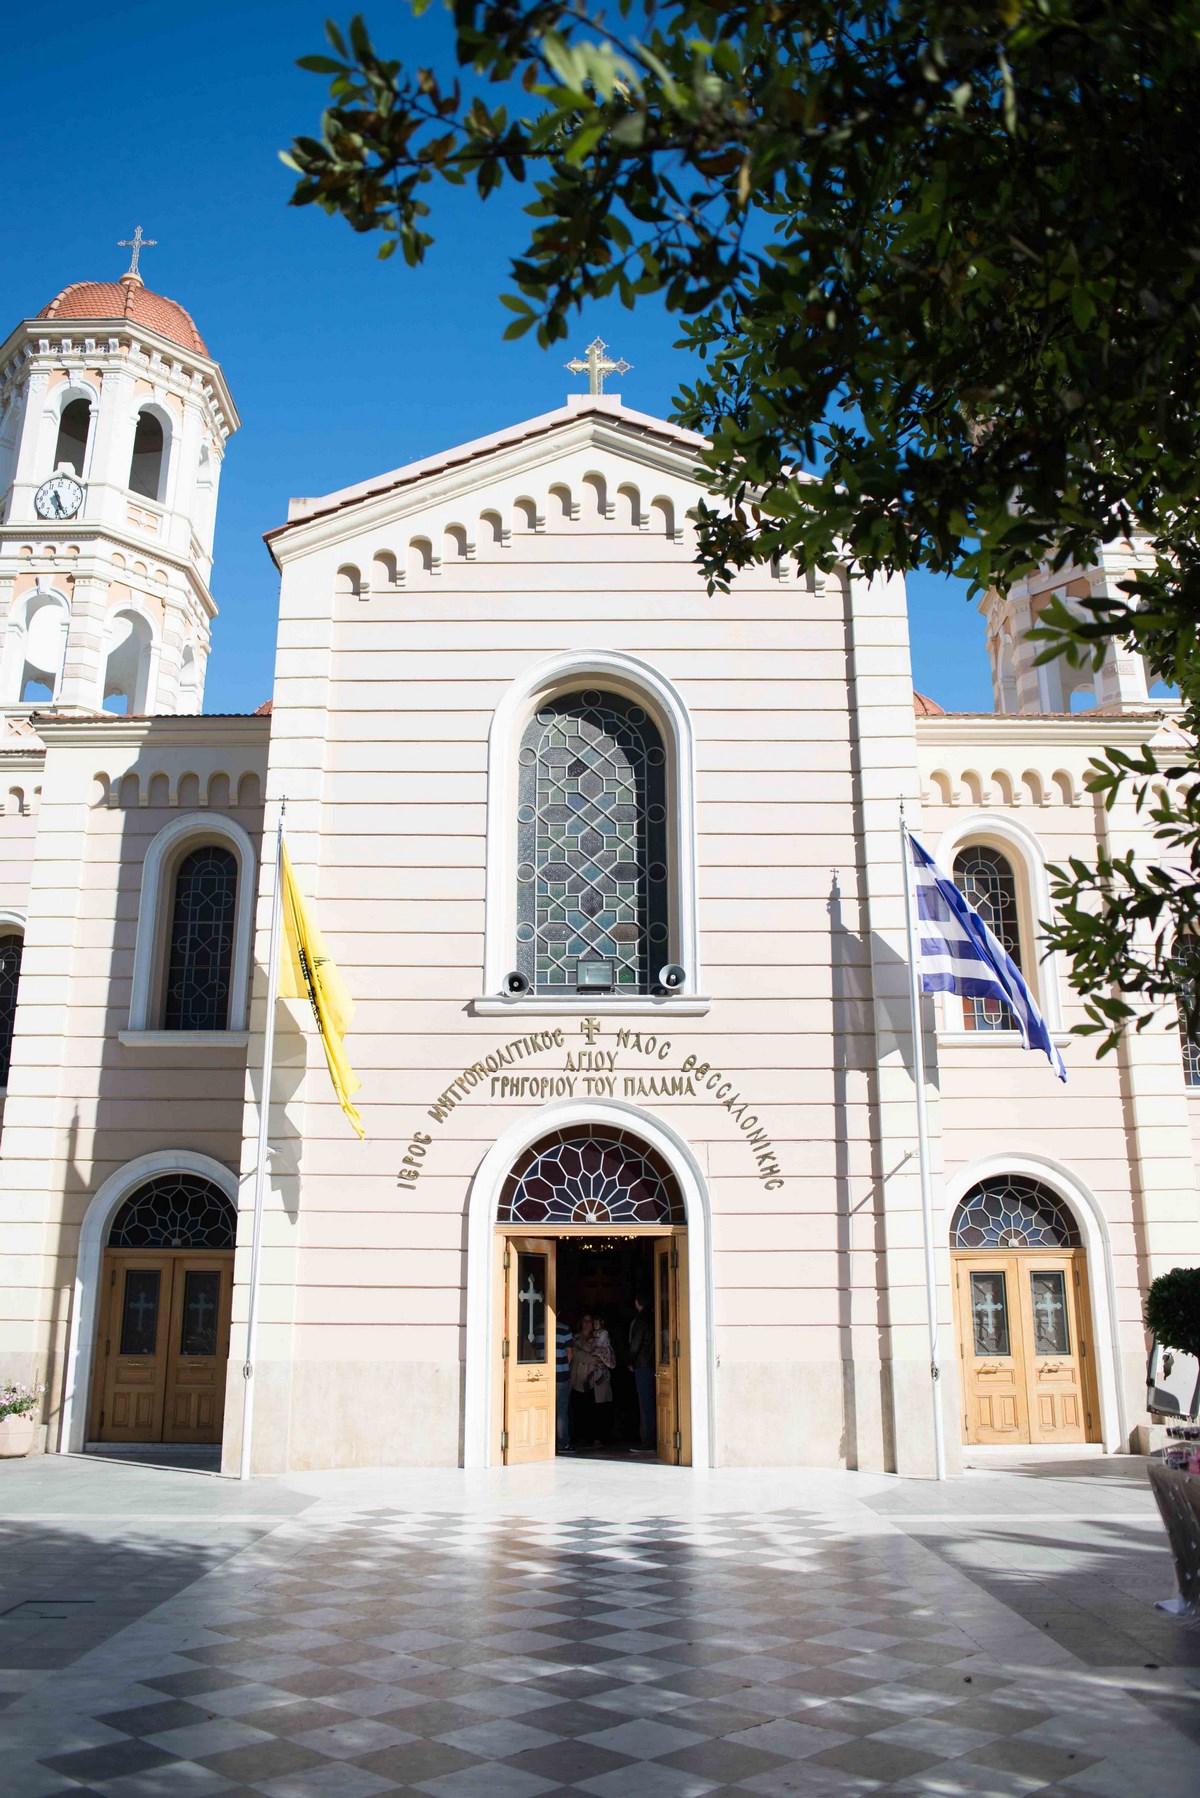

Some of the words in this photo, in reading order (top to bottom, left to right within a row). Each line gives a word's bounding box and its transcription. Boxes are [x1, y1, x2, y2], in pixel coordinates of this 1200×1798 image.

[563, 1050, 618, 1073] ΑΓΙΟΥ
[490, 1075, 578, 1098] ΓΡΗΓΟΡΙΟΥ
[582, 1075, 617, 1097] ΤΟΥ
[623, 1075, 697, 1097] ΠΑΛΑΜΑ
